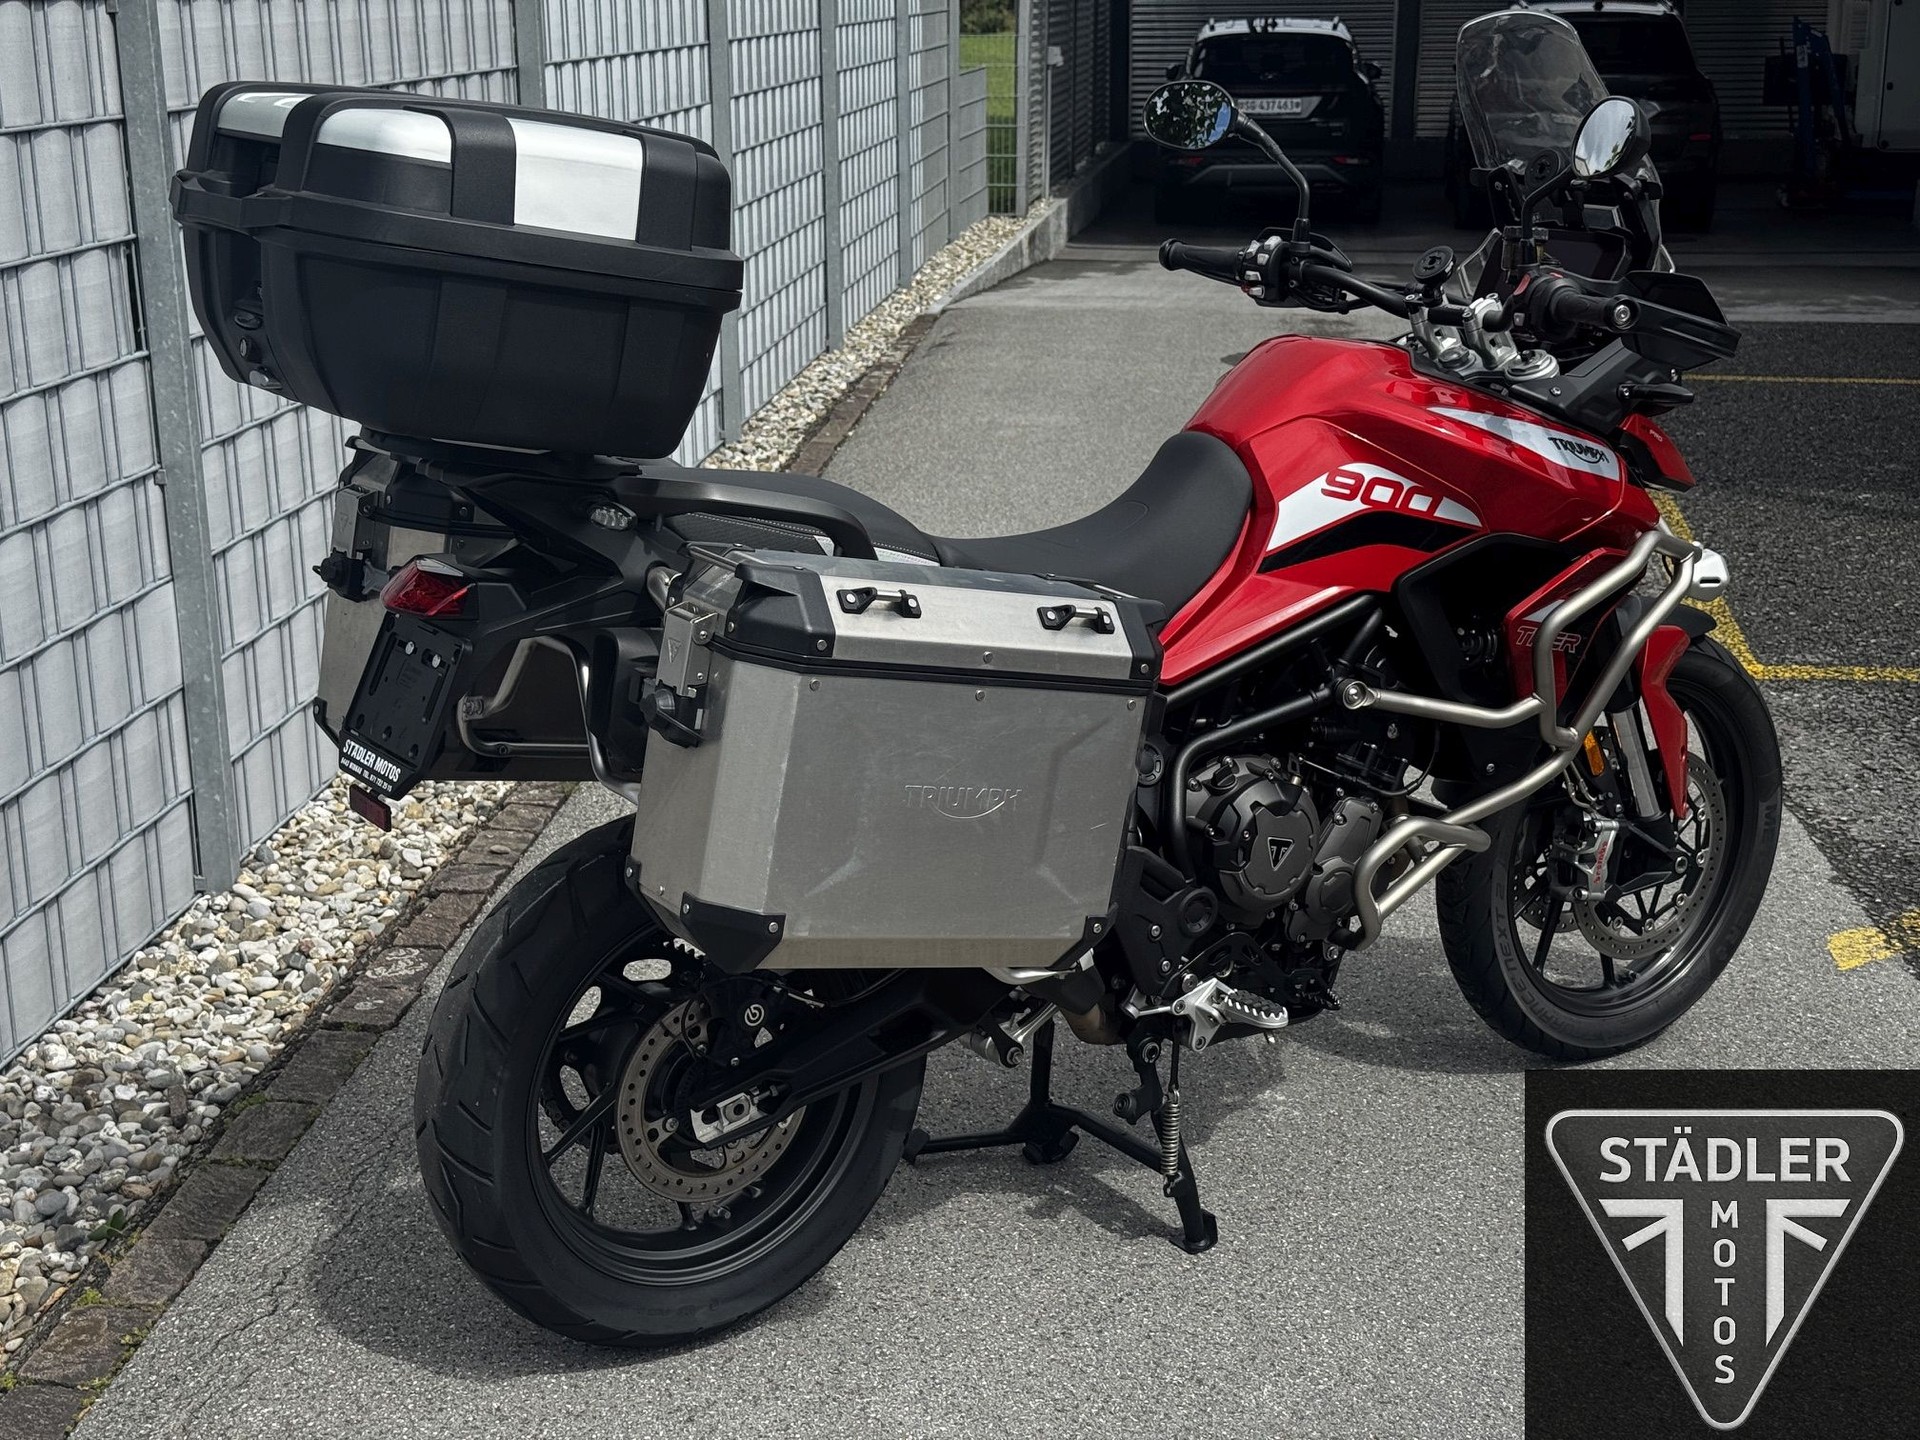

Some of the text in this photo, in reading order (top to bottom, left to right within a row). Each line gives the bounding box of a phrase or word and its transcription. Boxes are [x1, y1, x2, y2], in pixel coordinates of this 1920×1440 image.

[1548, 437, 1609, 463] TRIUMPH
[1321, 469, 1443, 516] 900
[1516, 626, 1581, 653] TIER
[373, 756, 401, 782] MOTOS
[905, 785, 1022, 818] TRIUMPH
